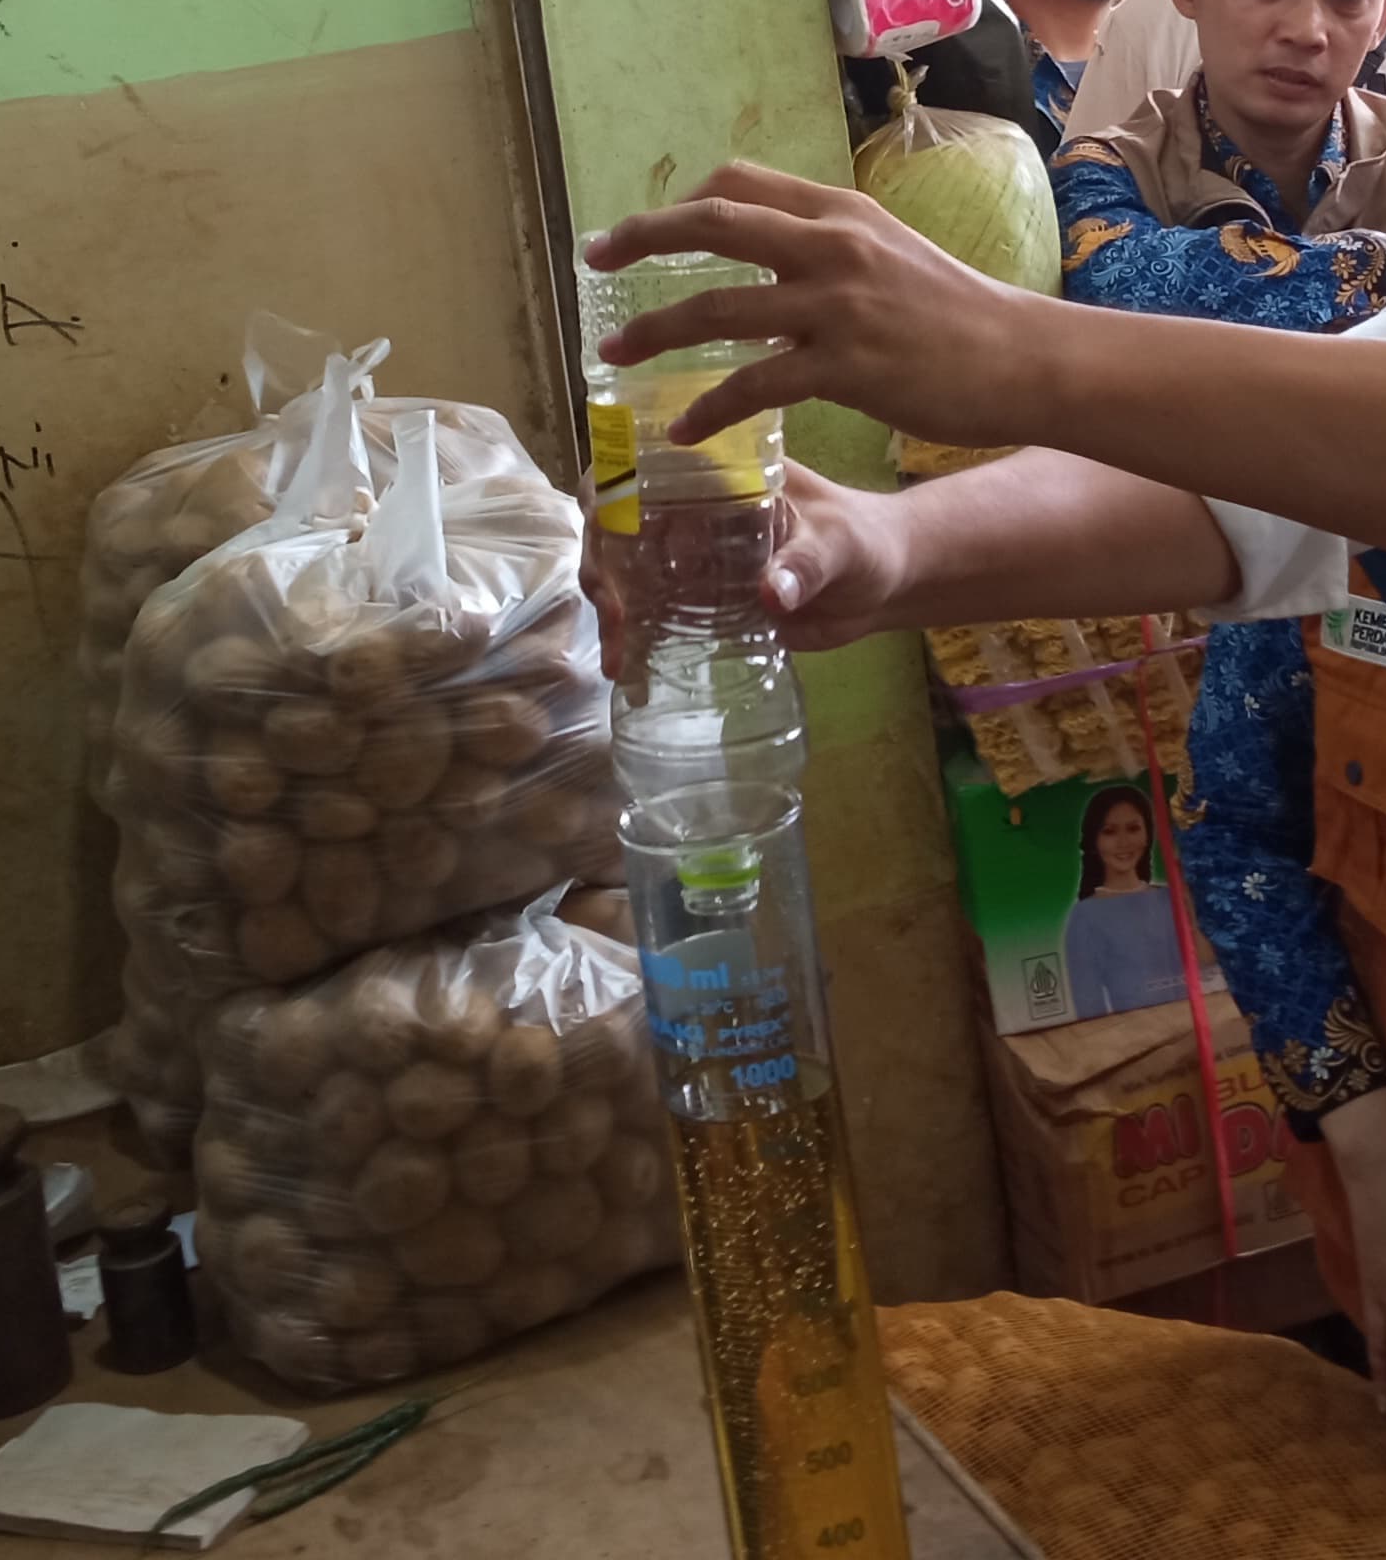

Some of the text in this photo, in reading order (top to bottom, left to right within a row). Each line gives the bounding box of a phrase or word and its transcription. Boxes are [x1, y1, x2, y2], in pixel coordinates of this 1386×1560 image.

[730, 1053, 797, 1090] 1000
[1115, 1093, 1200, 1179] MI
[804, 1439, 854, 1474] 500
[816, 1516, 866, 1550] 400
